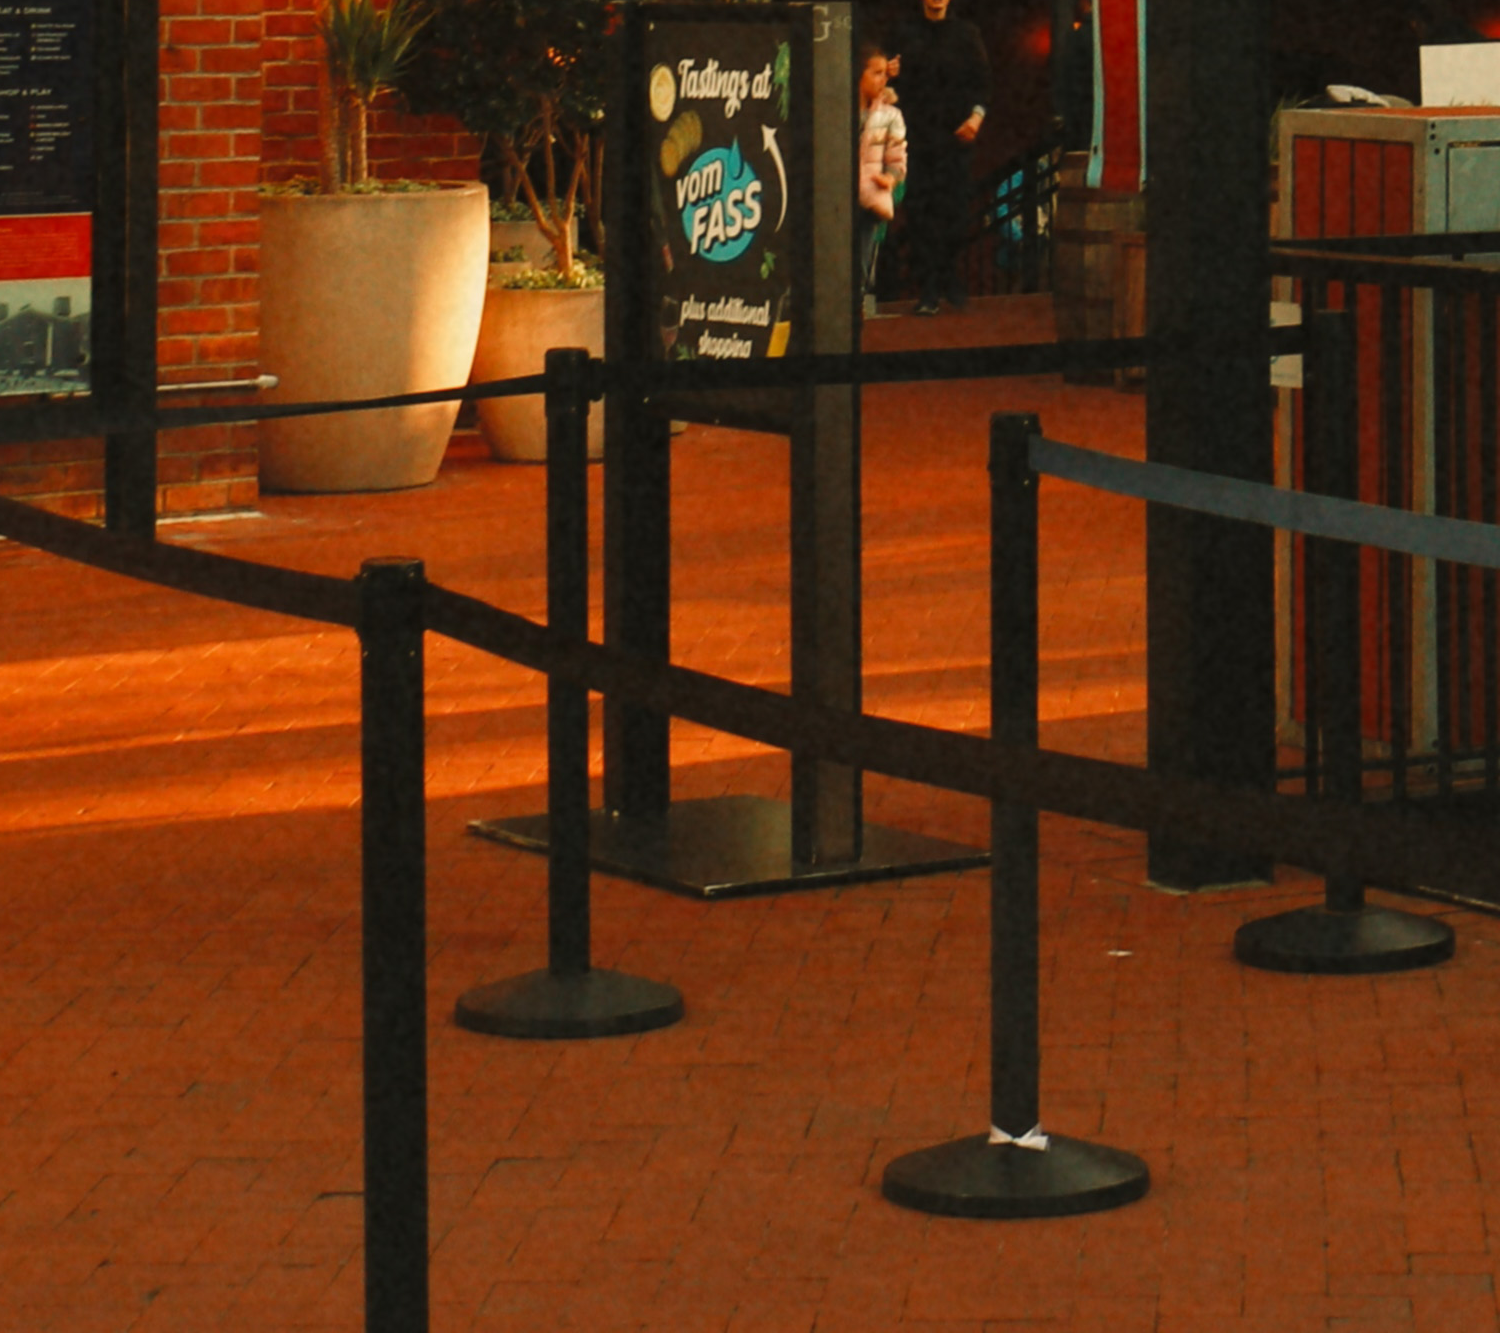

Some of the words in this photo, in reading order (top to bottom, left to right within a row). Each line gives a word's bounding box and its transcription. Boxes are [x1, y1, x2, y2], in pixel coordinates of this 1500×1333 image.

[678, 58, 750, 119] Tastings
[751, 63, 772, 99] at
[676, 159, 723, 209] vom
[690, 180, 762, 255] FASS
[680, 294, 706, 327] plus
[707, 296, 771, 327] additional
